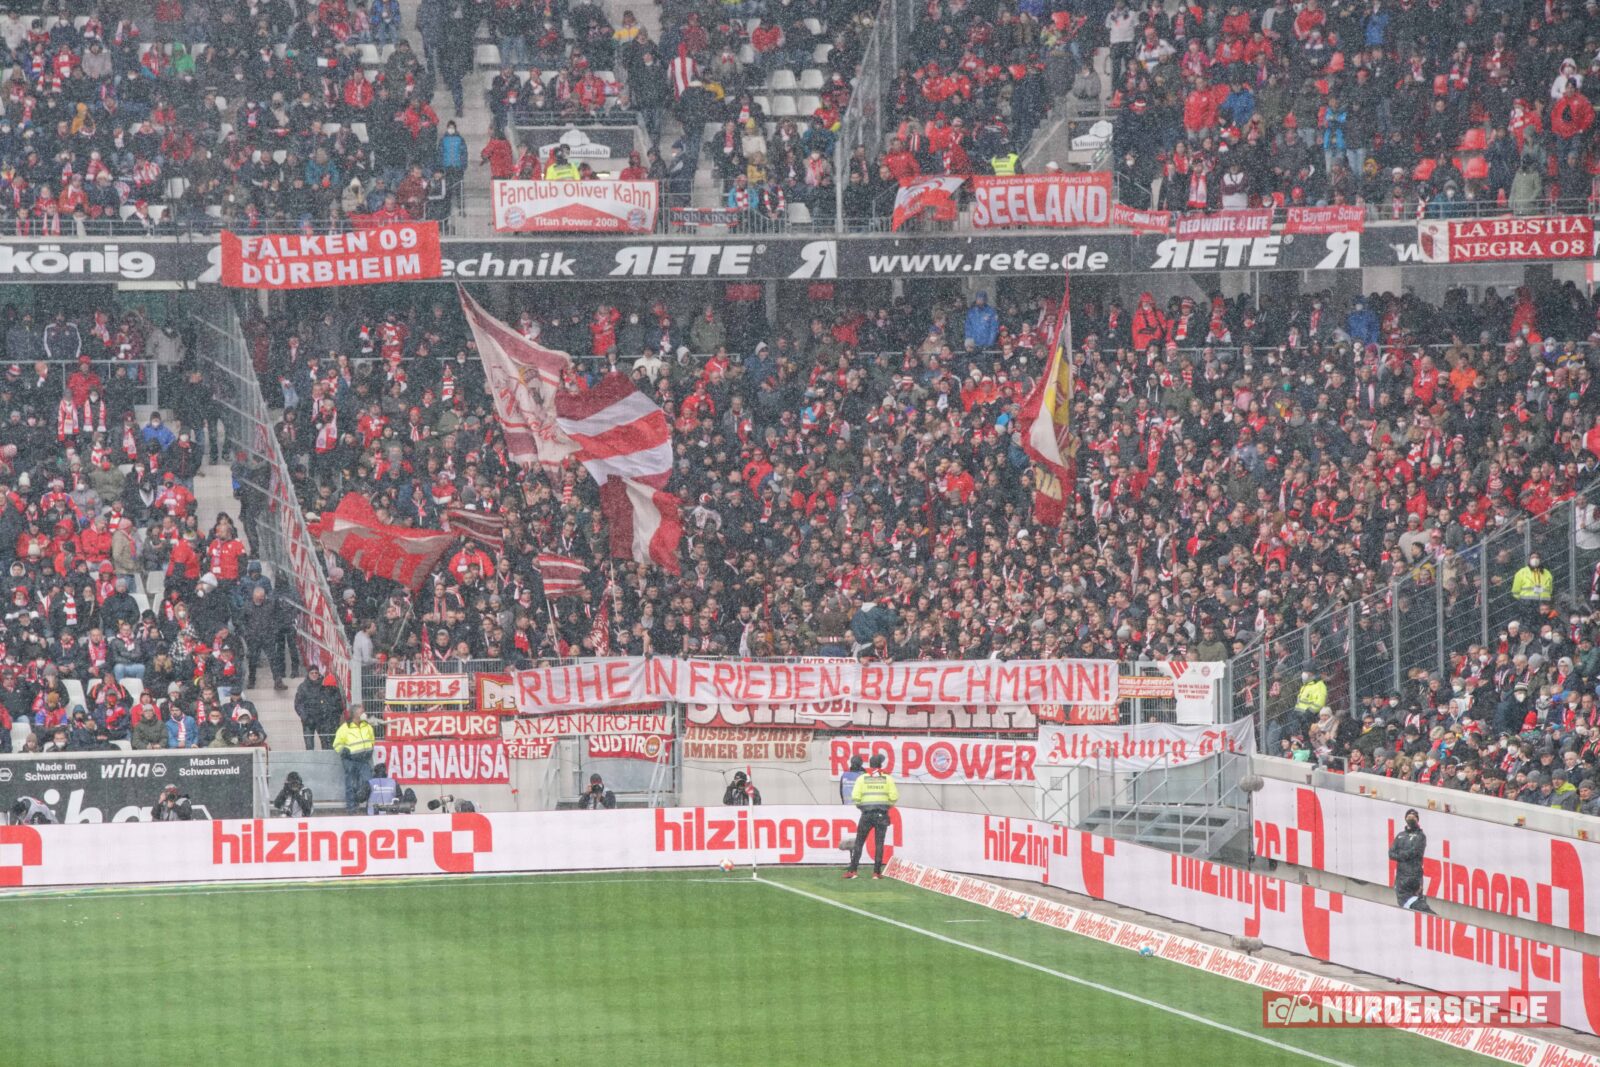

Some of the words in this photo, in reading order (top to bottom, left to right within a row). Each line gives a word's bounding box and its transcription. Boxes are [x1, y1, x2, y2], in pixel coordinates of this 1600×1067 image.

[500, 183, 558, 207] Fanclub
[564, 182, 608, 199] Oliver
[613, 182, 651, 209] Kahn
[974, 185, 1107, 226] SEELAND
[535, 217, 559, 227] Titan
[562, 217, 593, 228] Power
[595, 218, 618, 228] 2008
[1179, 220, 1200, 234] RED
[1201, 217, 1235, 231] WHITE
[1246, 216, 1268, 230] LIFE
[1288, 208, 1300, 222] FC
[1455, 222, 1487, 238] LA
[1494, 218, 1587, 236] BESTIA
[868, 245, 1109, 273] www.rete.de
[1454, 240, 1544, 258] NEGRA
[242, 254, 421, 285] DÜRBHEIM
[396, 680, 461, 698] REBELS
[517, 661, 631, 707] RUHE
[645, 656, 677, 696] IN
[860, 662, 1110, 703] BUSCHMANN!
[1077, 705, 1117, 722] PRIDE
[387, 715, 497, 737] HARZBURG
[514, 715, 666, 737] ANZENKIRCHEN
[508, 745, 548, 759] REIHE
[684, 743, 738, 758] IMMER
[743, 743, 769, 758] BEI
[774, 743, 806, 759] UNS
[1048, 732, 1188, 764] Altenburg
[36, 763, 63, 771] Made
[65, 762, 77, 771] im
[101, 759, 151, 779] wiha
[179, 765, 240, 776] Schwarzwald
[190, 758, 216, 767] Made
[217, 757, 229, 766] im
[902, 741, 1037, 780] POWER
[25, 770, 87, 781] Schwarzwald
[655, 807, 858, 864] hilzinger
[212, 819, 424, 876] hilzinger
